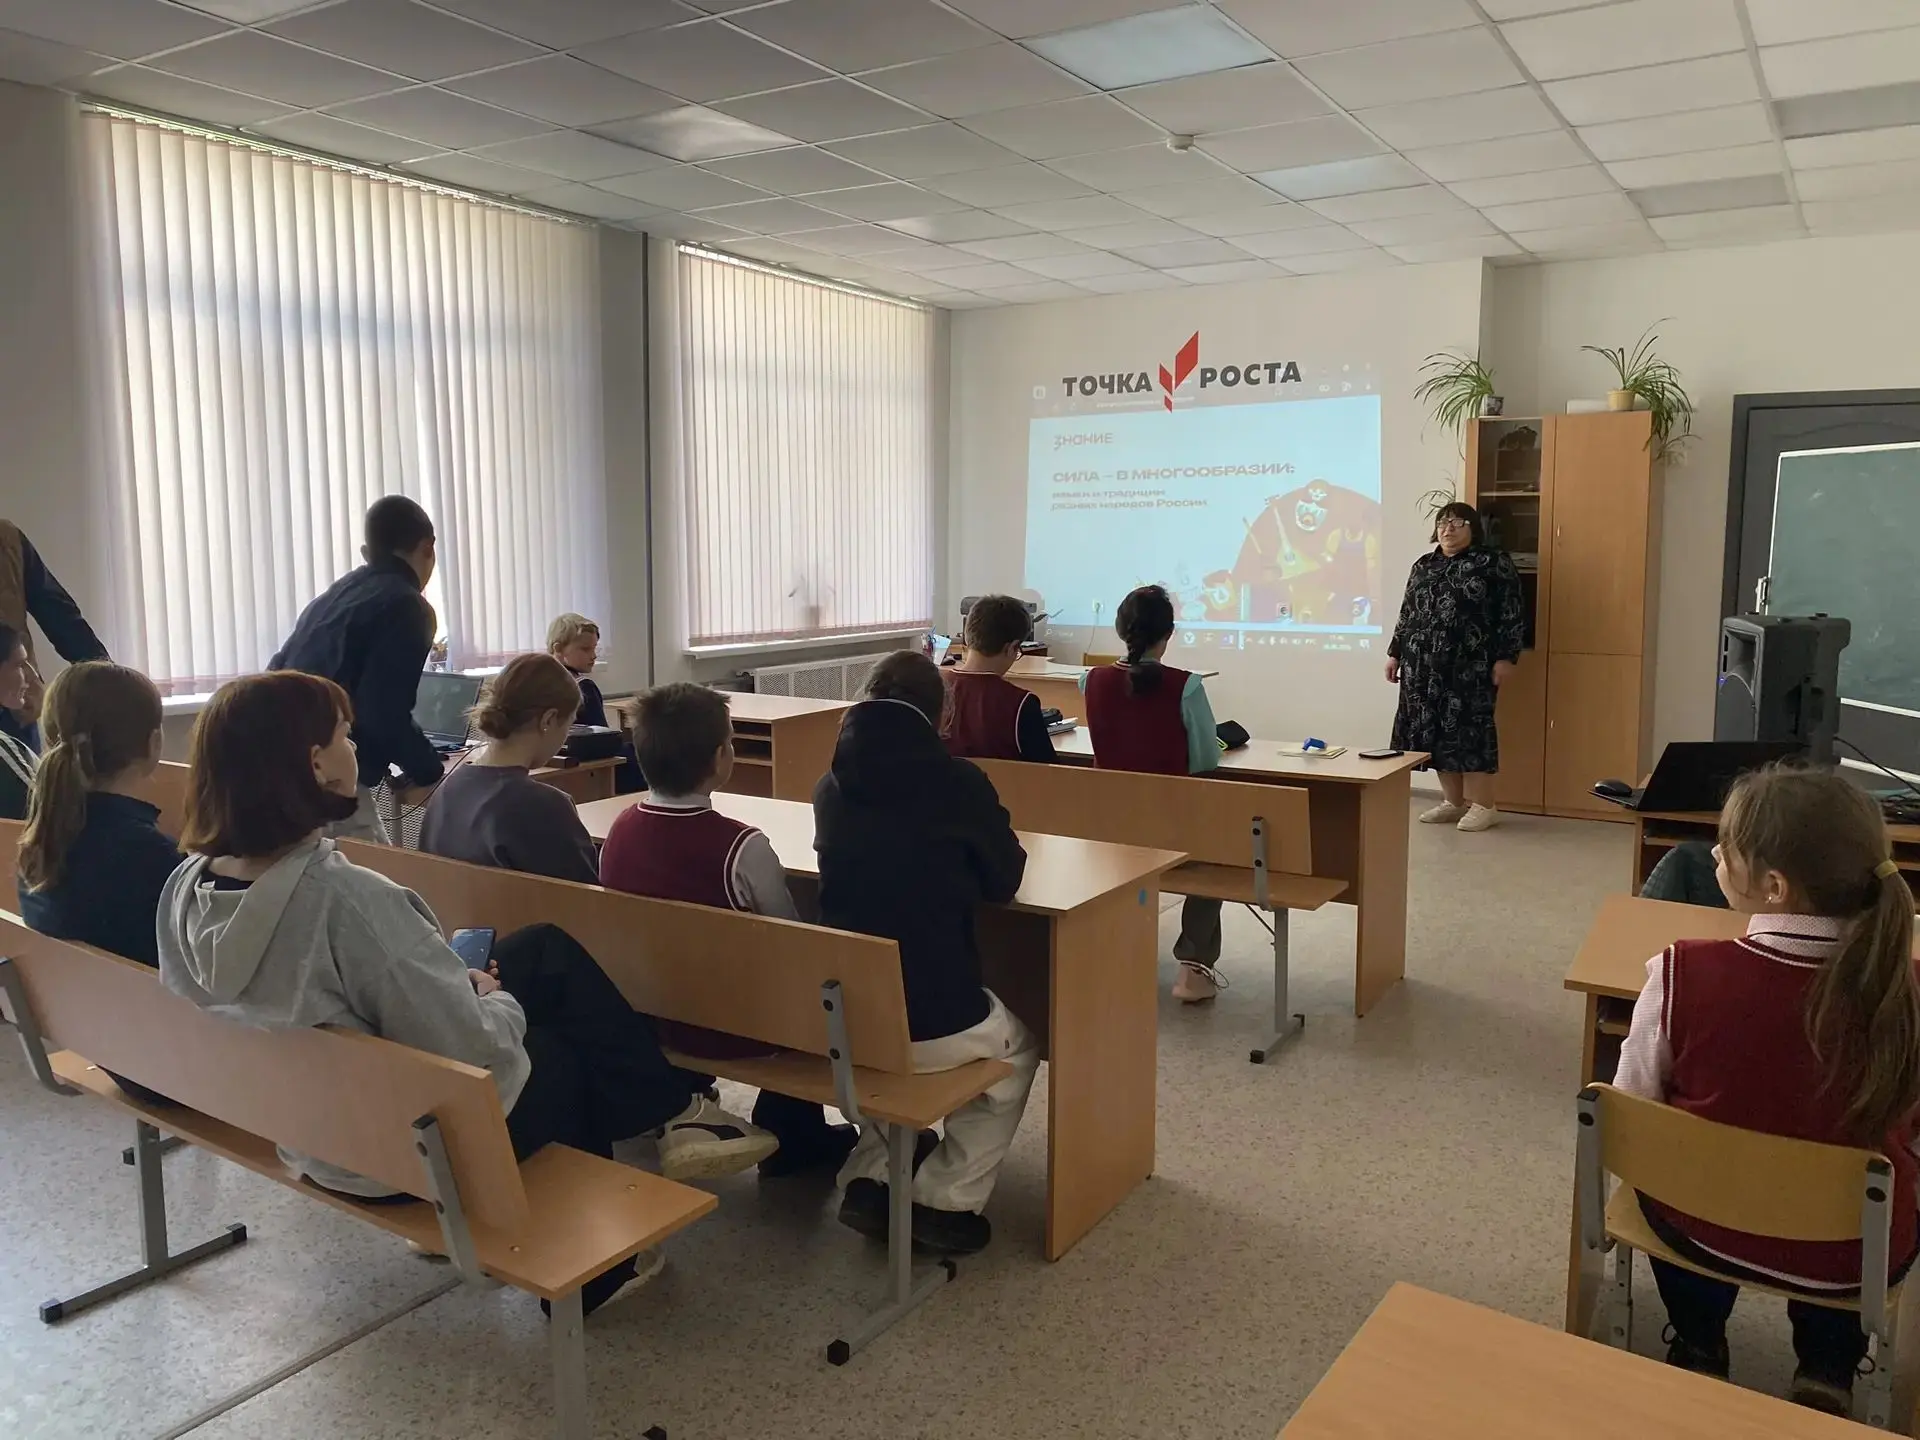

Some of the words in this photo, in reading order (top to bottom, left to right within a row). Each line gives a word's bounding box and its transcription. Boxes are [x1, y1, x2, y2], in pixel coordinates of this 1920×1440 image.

[1062, 372, 1153, 397] ТОЧКА
[1199, 361, 1303, 389] РОСТА
[1052, 471, 1100, 483] СИЛА
[1116, 470, 1128, 481] В
[1131, 462, 1295, 481] МНОГООБРАЗИИ:
[1156, 498, 1208, 508] России
